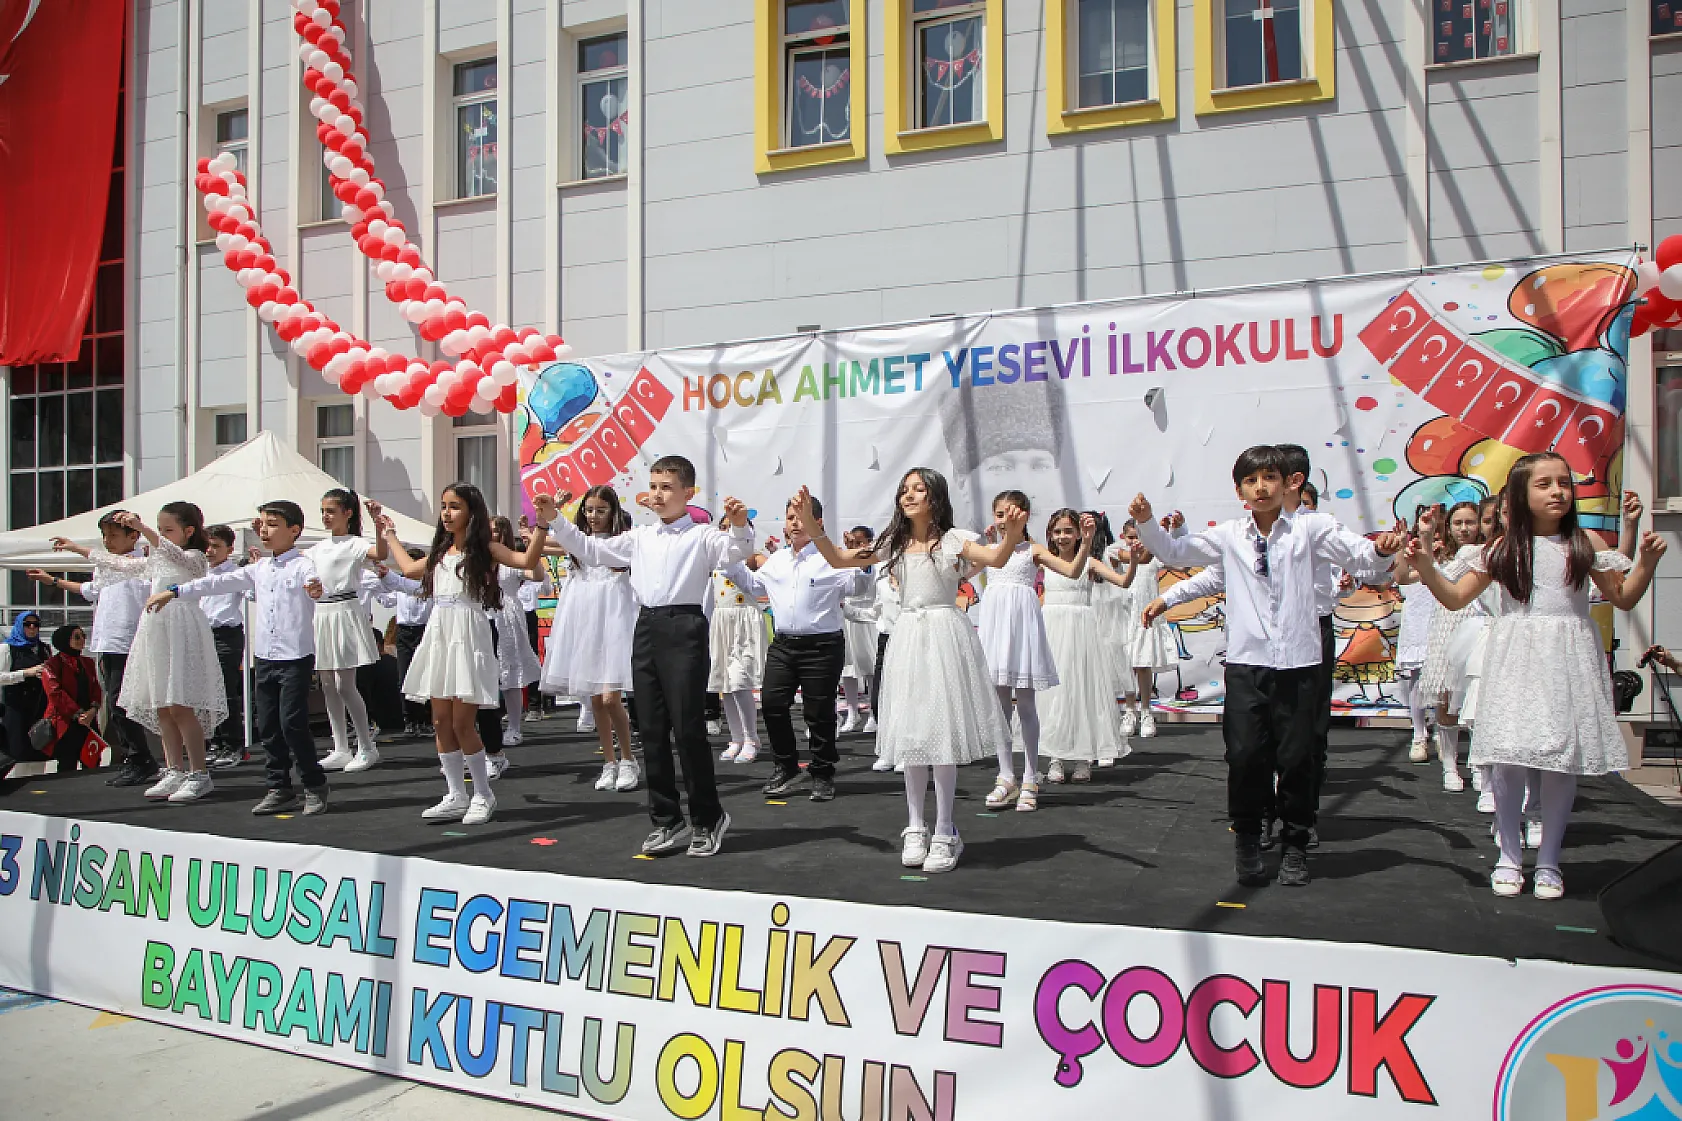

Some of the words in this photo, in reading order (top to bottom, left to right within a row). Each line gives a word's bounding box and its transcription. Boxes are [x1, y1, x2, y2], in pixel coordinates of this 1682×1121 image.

[683, 369, 782, 411] HOCA
[793, 354, 931, 403] AHMET
[942, 324, 1091, 388] YESEVİ
[1108, 313, 1343, 375] İLKOKULU
[30, 823, 174, 921] NİSAN
[187, 857, 398, 958] ULUSAL
[413, 886, 856, 1028] EGEMENLİK
[877, 939, 1007, 1048] VE
[1034, 958, 1438, 1105] ÇOCUK
[141, 940, 394, 1058] BAYRAMI
[406, 987, 636, 1104] KUTLU
[655, 1031, 957, 1121] OLSUN
